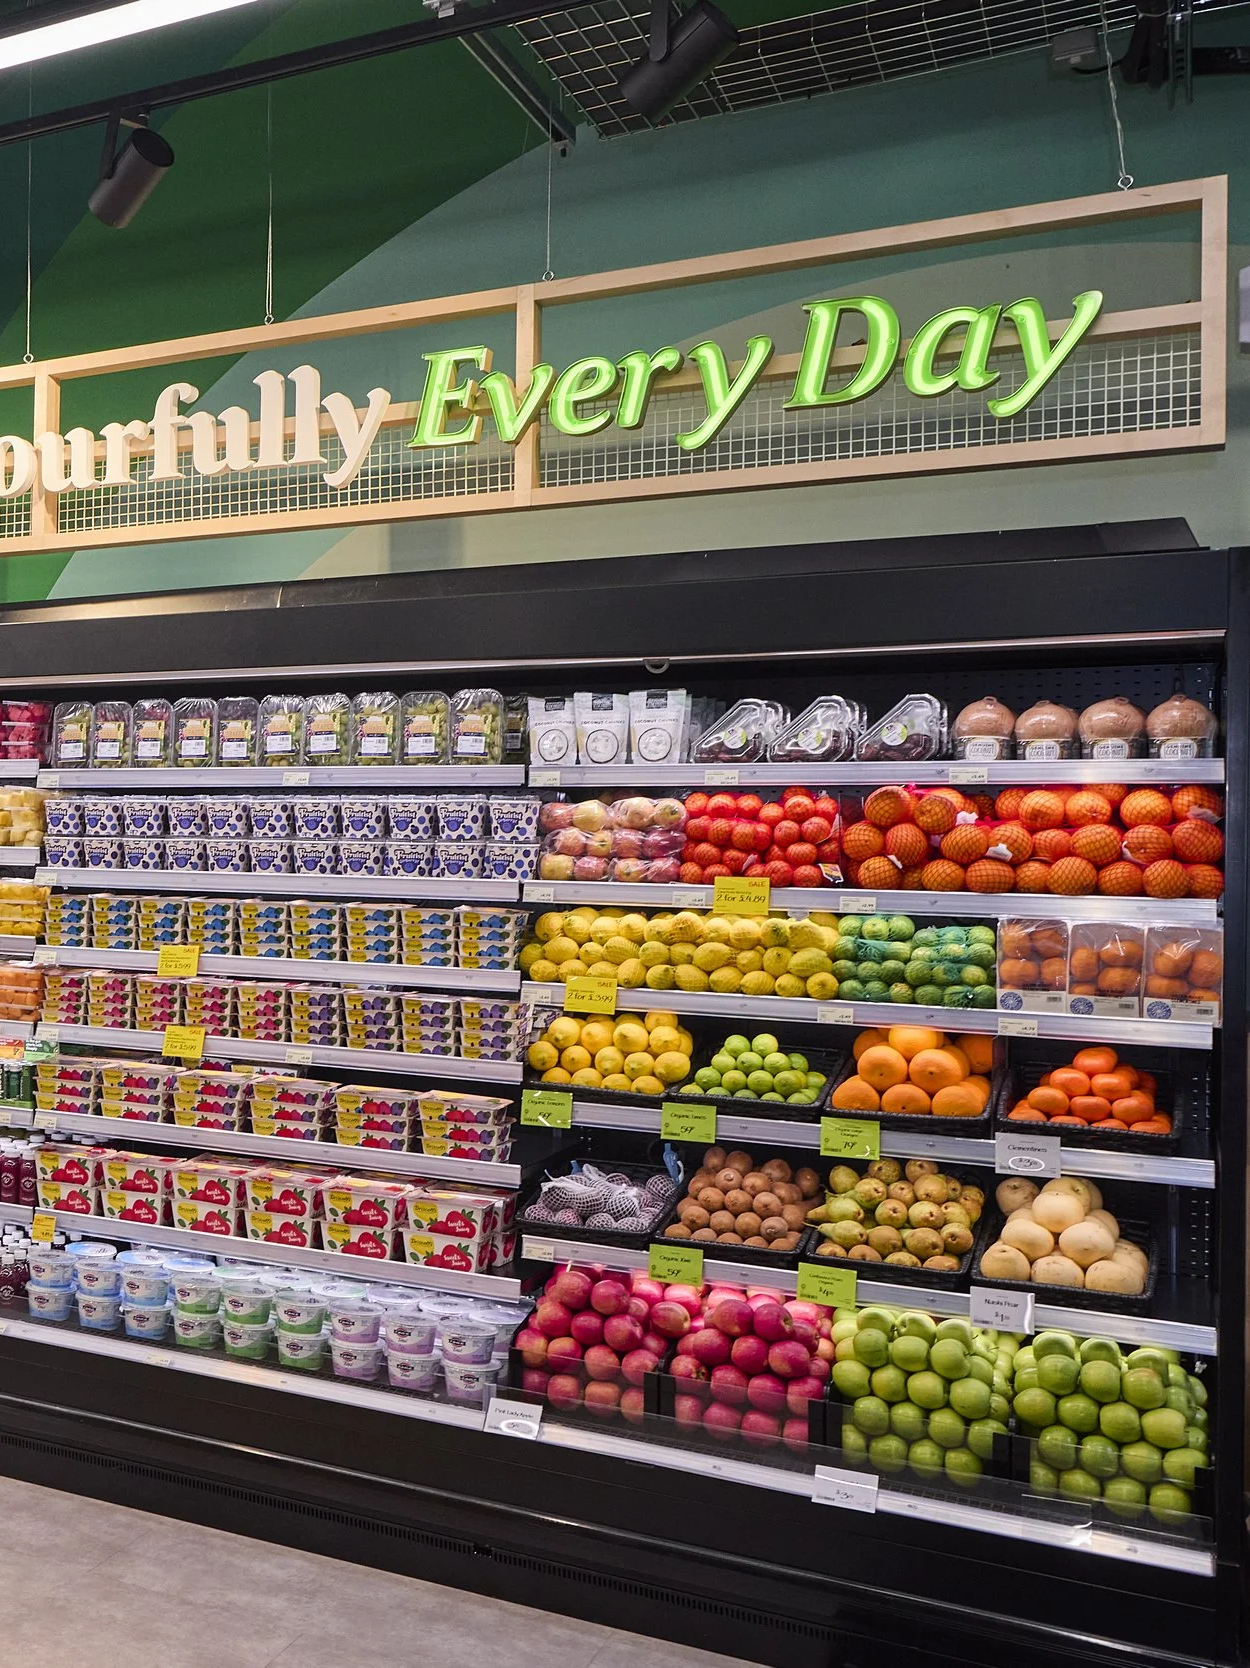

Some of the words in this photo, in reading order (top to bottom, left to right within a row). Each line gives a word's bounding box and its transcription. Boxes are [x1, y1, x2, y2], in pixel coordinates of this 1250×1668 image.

[408, 335, 774, 450] Every
[782, 290, 1103, 418] Day
[390, 808, 416, 819] Fruitist
[440, 807, 468, 819] Fruitist
[493, 808, 522, 820] Fruitist
[394, 849, 424, 861] Fruitist
[440, 849, 469, 862] Fruitist
[489, 850, 514, 862] Fruitist
[724, 893, 737, 902] for
